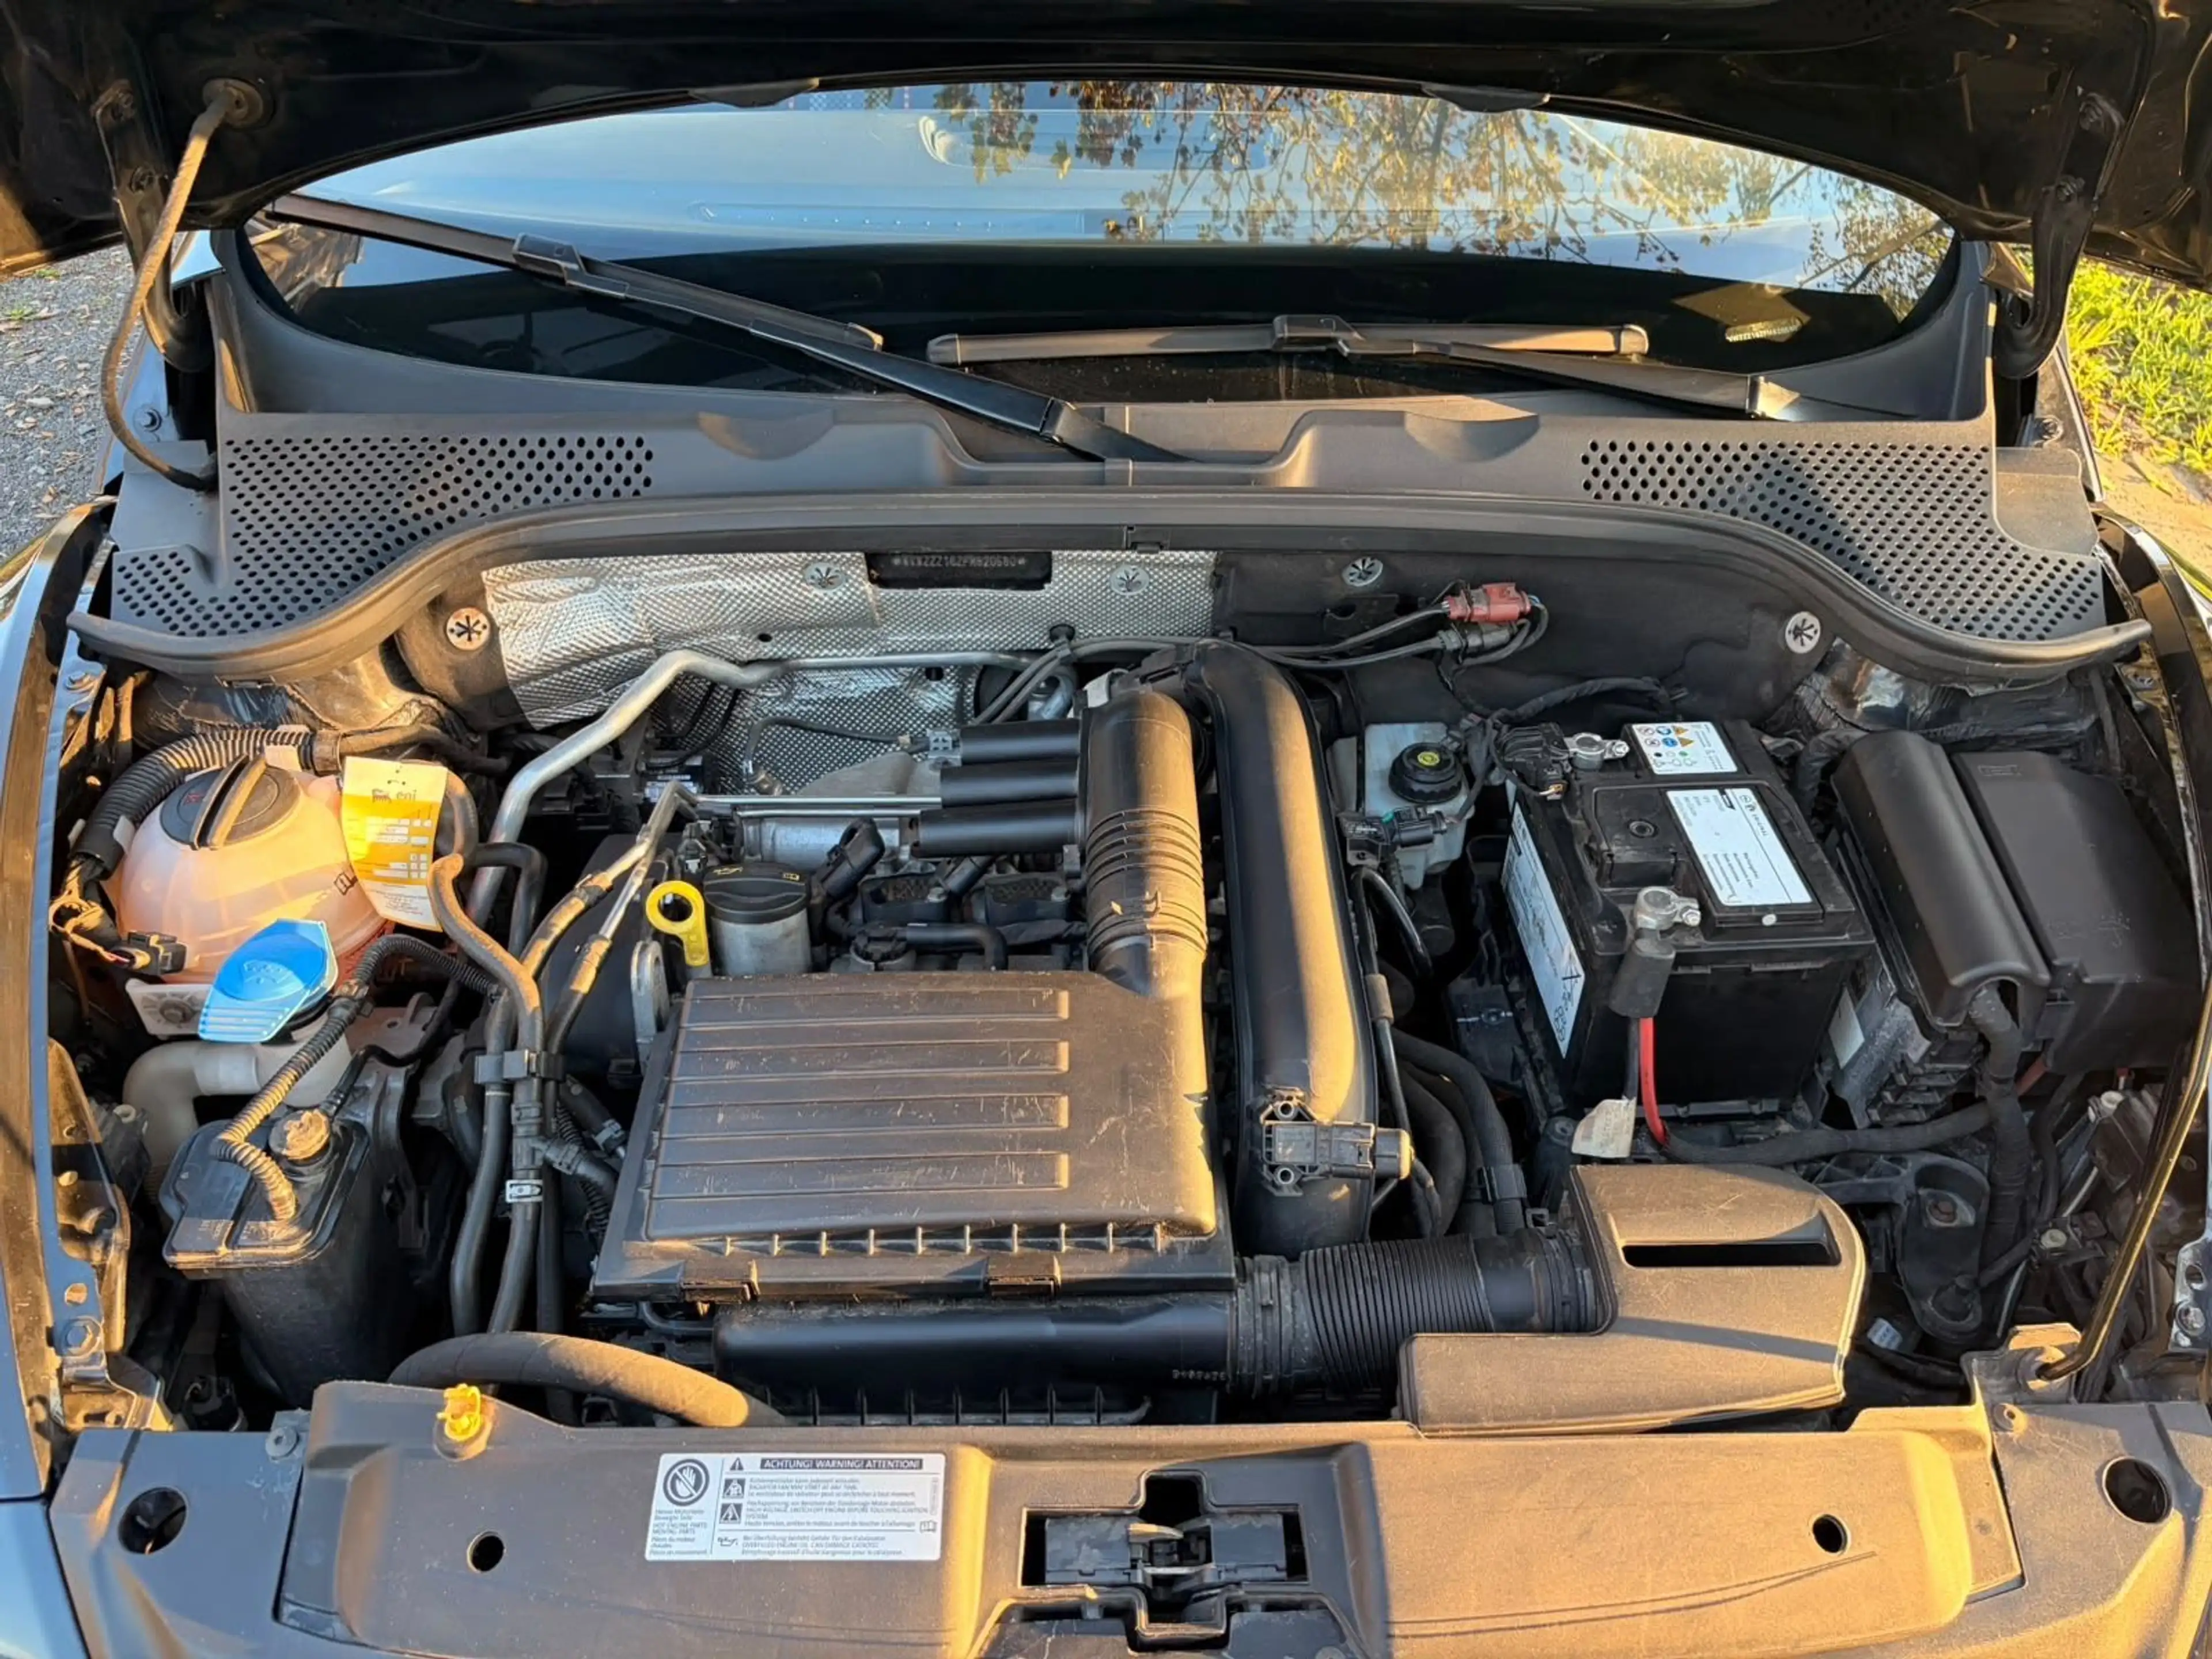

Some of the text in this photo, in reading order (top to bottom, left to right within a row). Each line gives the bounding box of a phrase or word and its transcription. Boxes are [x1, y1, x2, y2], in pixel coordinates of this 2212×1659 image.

[396, 789, 417, 802] eni
[764, 1459, 920, 1468] ACHTUNG! WARNING! ATTENTION!
